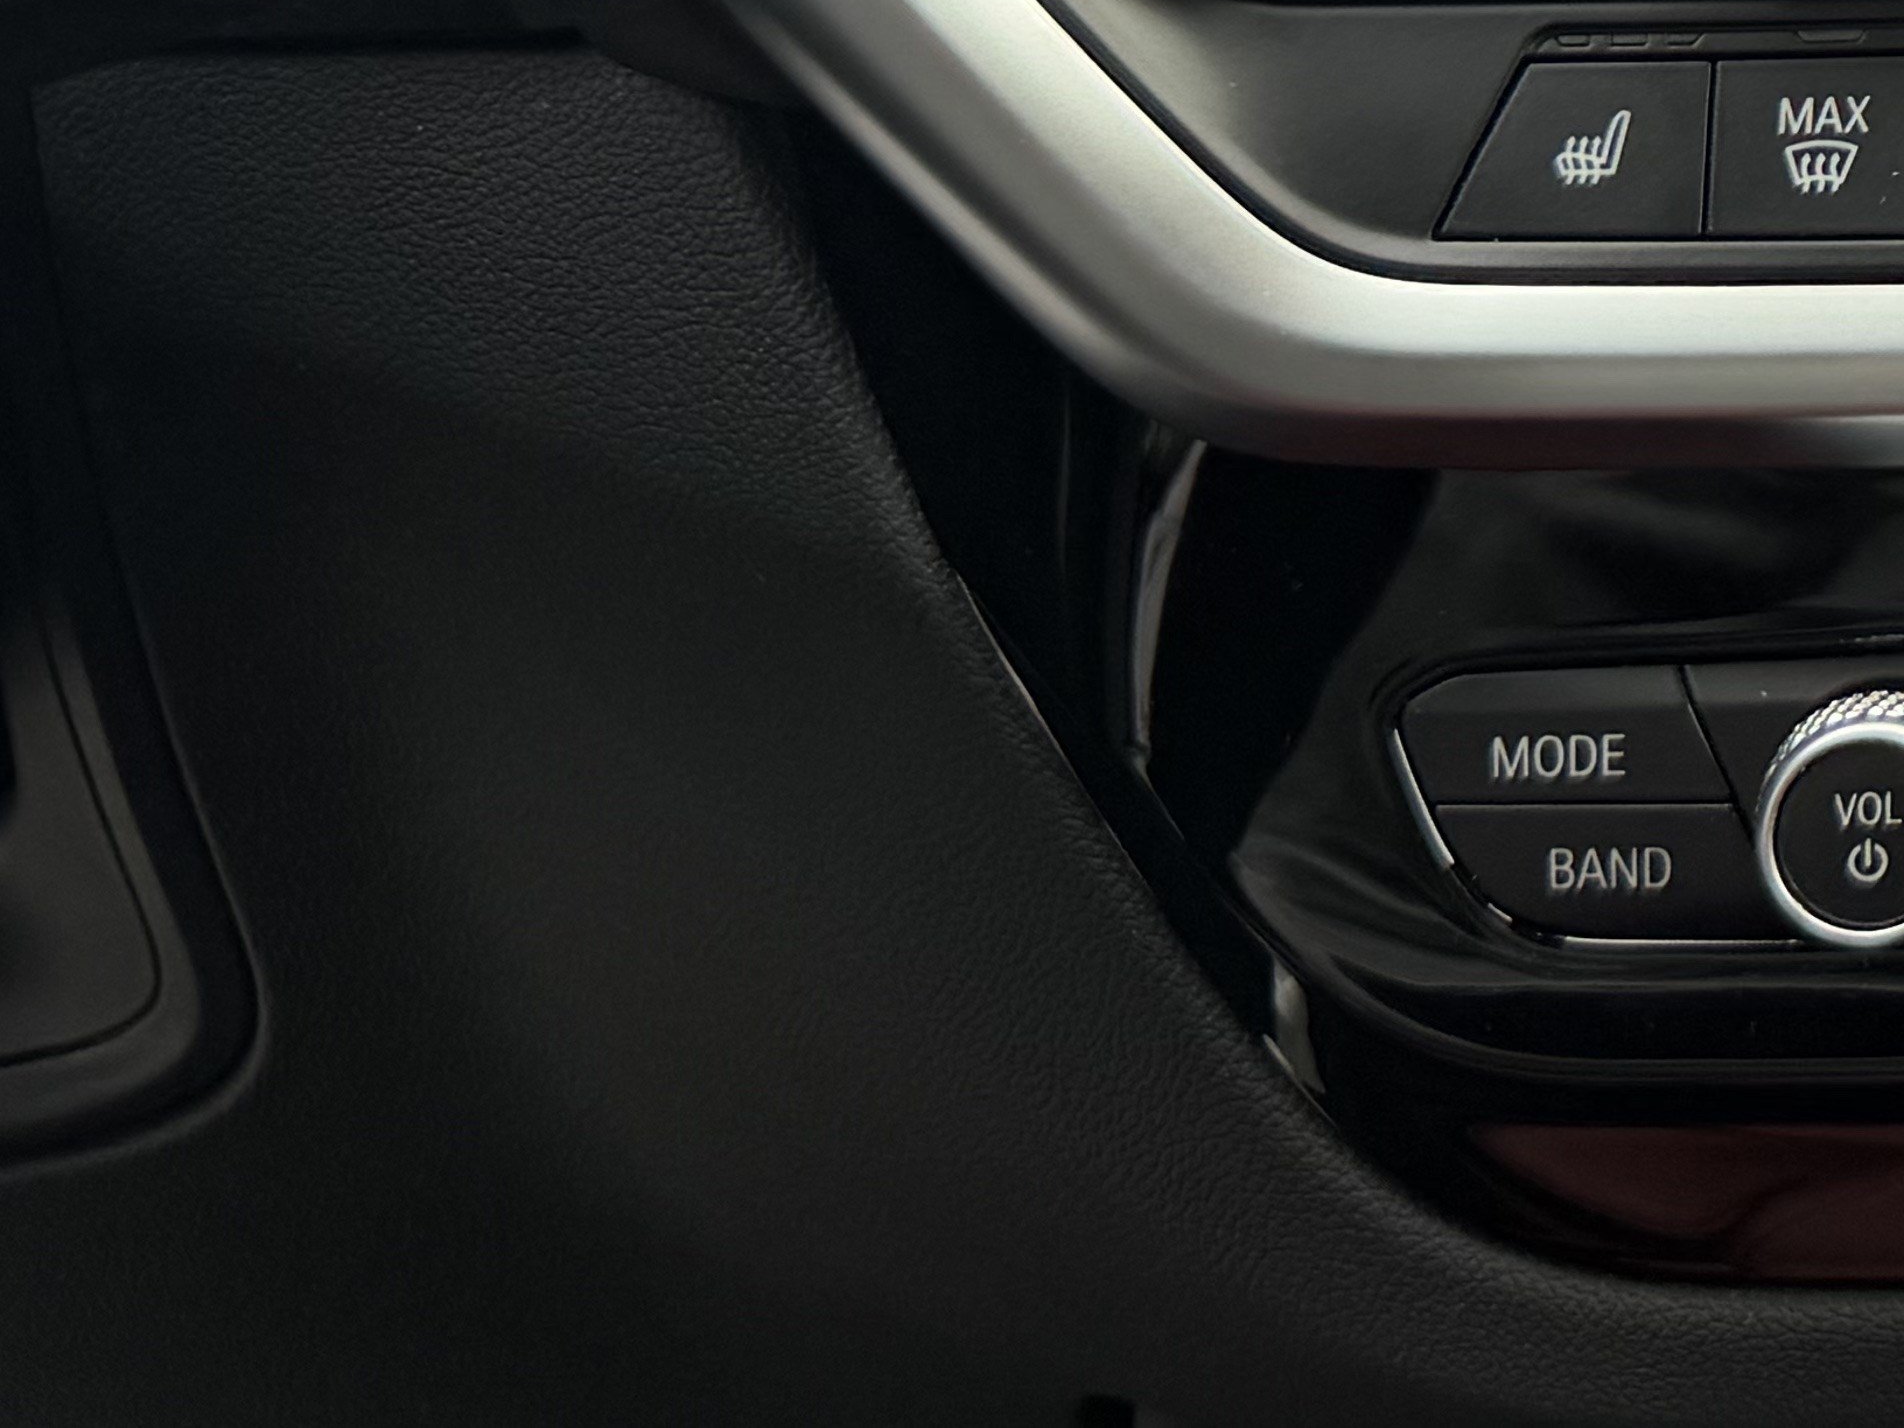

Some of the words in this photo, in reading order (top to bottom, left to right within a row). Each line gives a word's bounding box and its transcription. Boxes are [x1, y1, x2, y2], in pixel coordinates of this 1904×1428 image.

[1776, 94, 1872, 137] MAX
[1490, 732, 1626, 782] MODE
[1834, 792, 1904, 828] VOL
[1549, 846, 1673, 894] BAND
